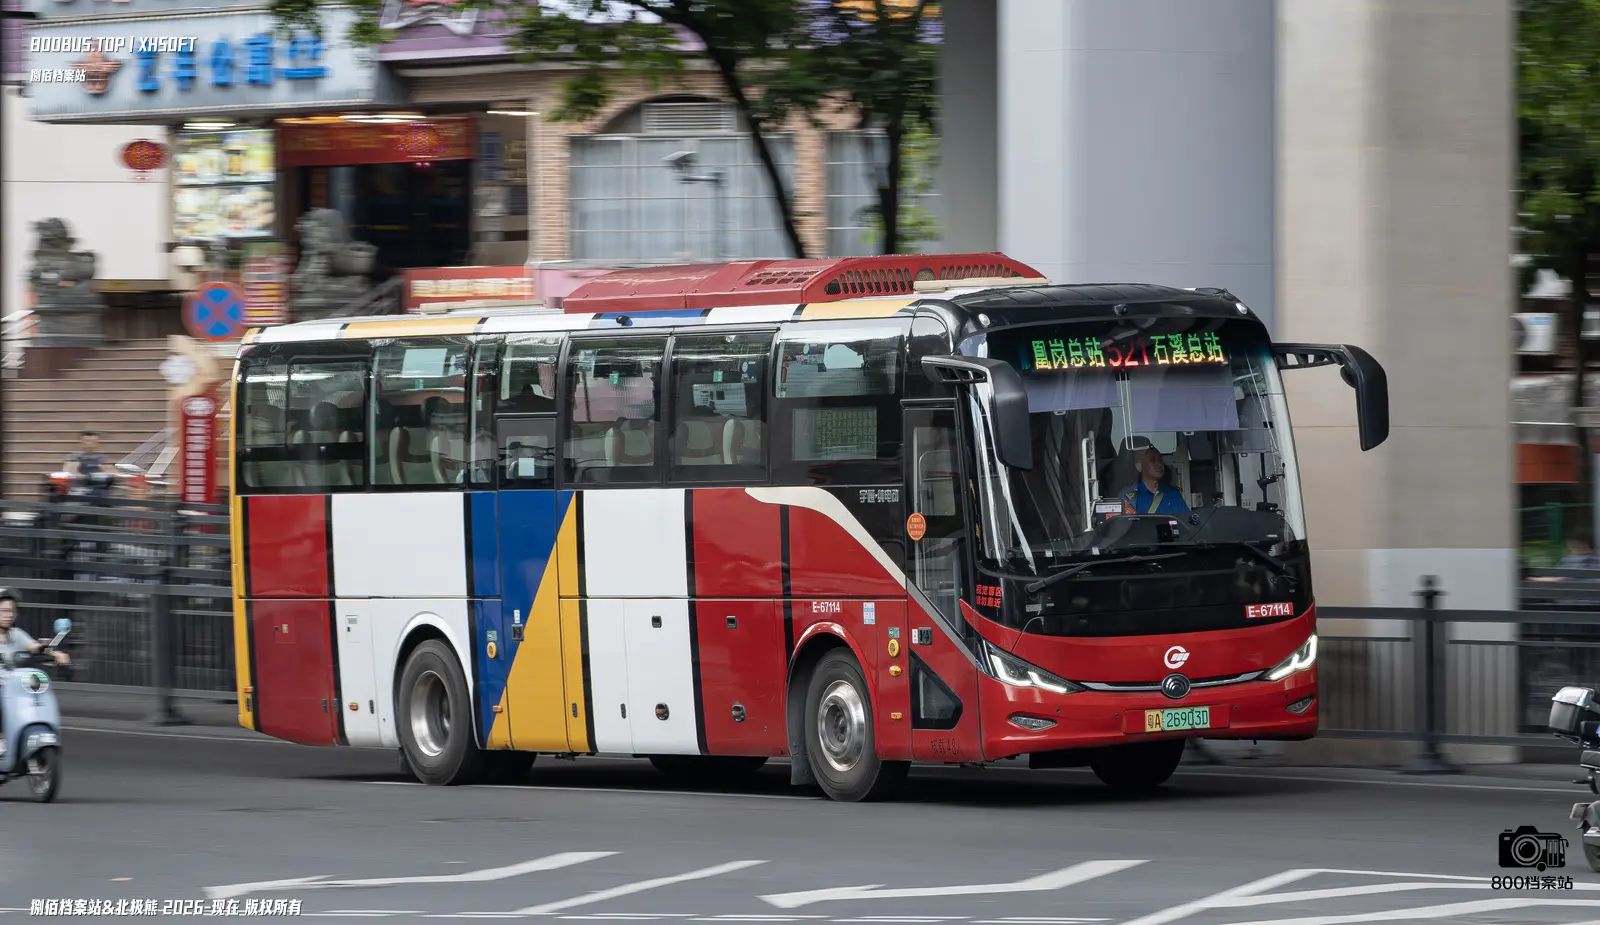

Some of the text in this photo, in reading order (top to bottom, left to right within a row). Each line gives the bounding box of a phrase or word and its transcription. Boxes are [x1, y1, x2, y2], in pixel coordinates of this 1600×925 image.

[1151, 332, 1226, 364] 石溪总站
[812, 601, 840, 613] E-67114
[1248, 604, 1290, 618] E-67114
[1166, 710, 1209, 728] 26903D
